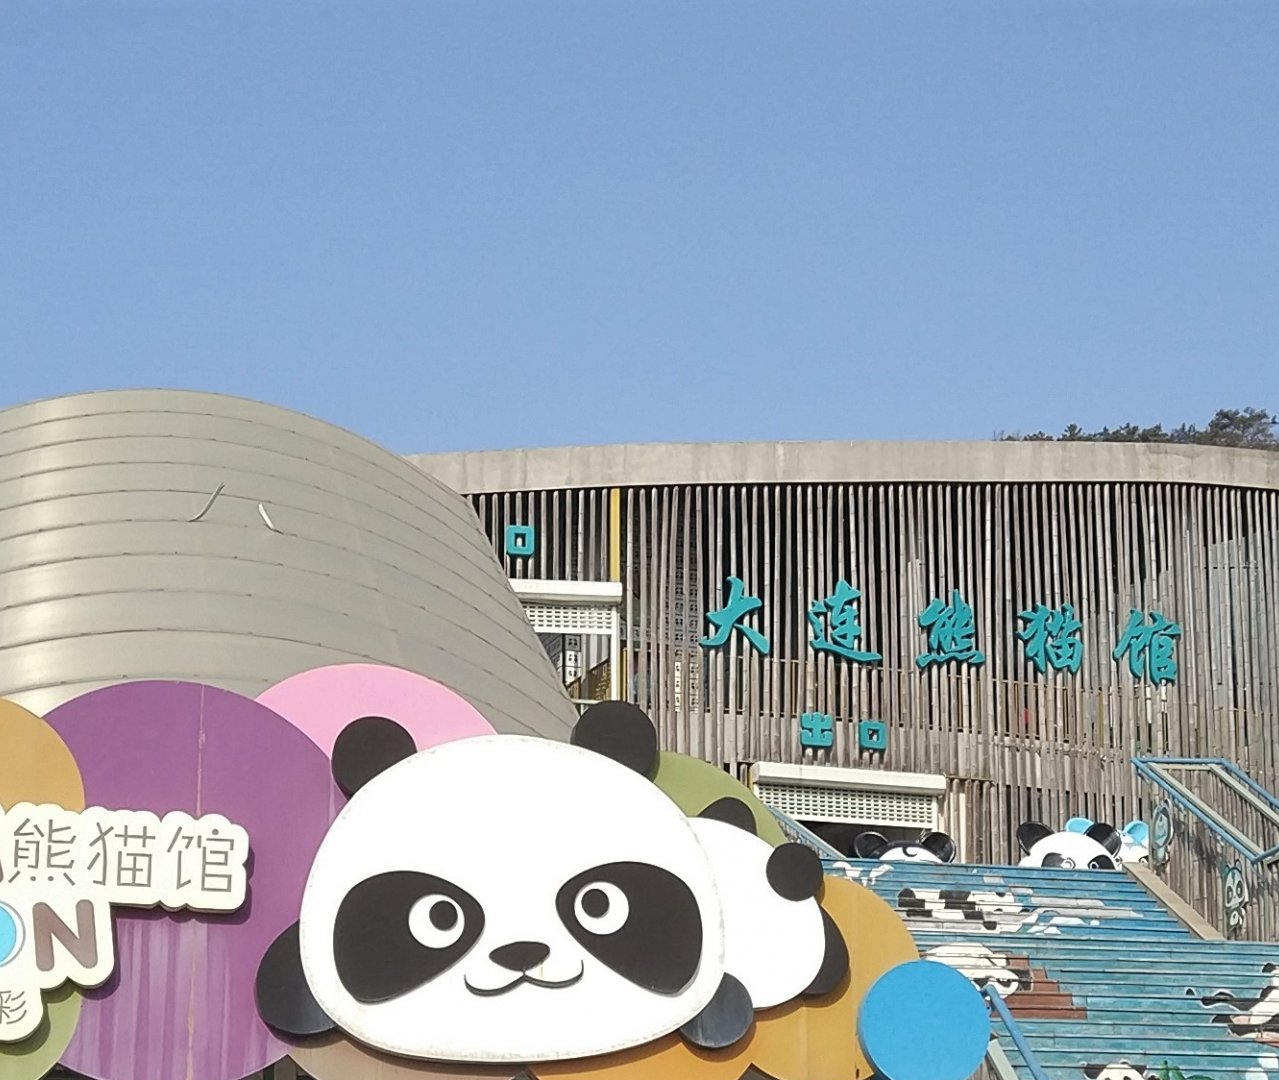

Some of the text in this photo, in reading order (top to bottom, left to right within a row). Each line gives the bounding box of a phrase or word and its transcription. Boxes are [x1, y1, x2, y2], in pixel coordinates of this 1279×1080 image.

[698, 575, 1183, 686] 大连熊猫馆
[800, 711, 887, 750] 出口
[7, 816, 240, 895] 熊猫馆
